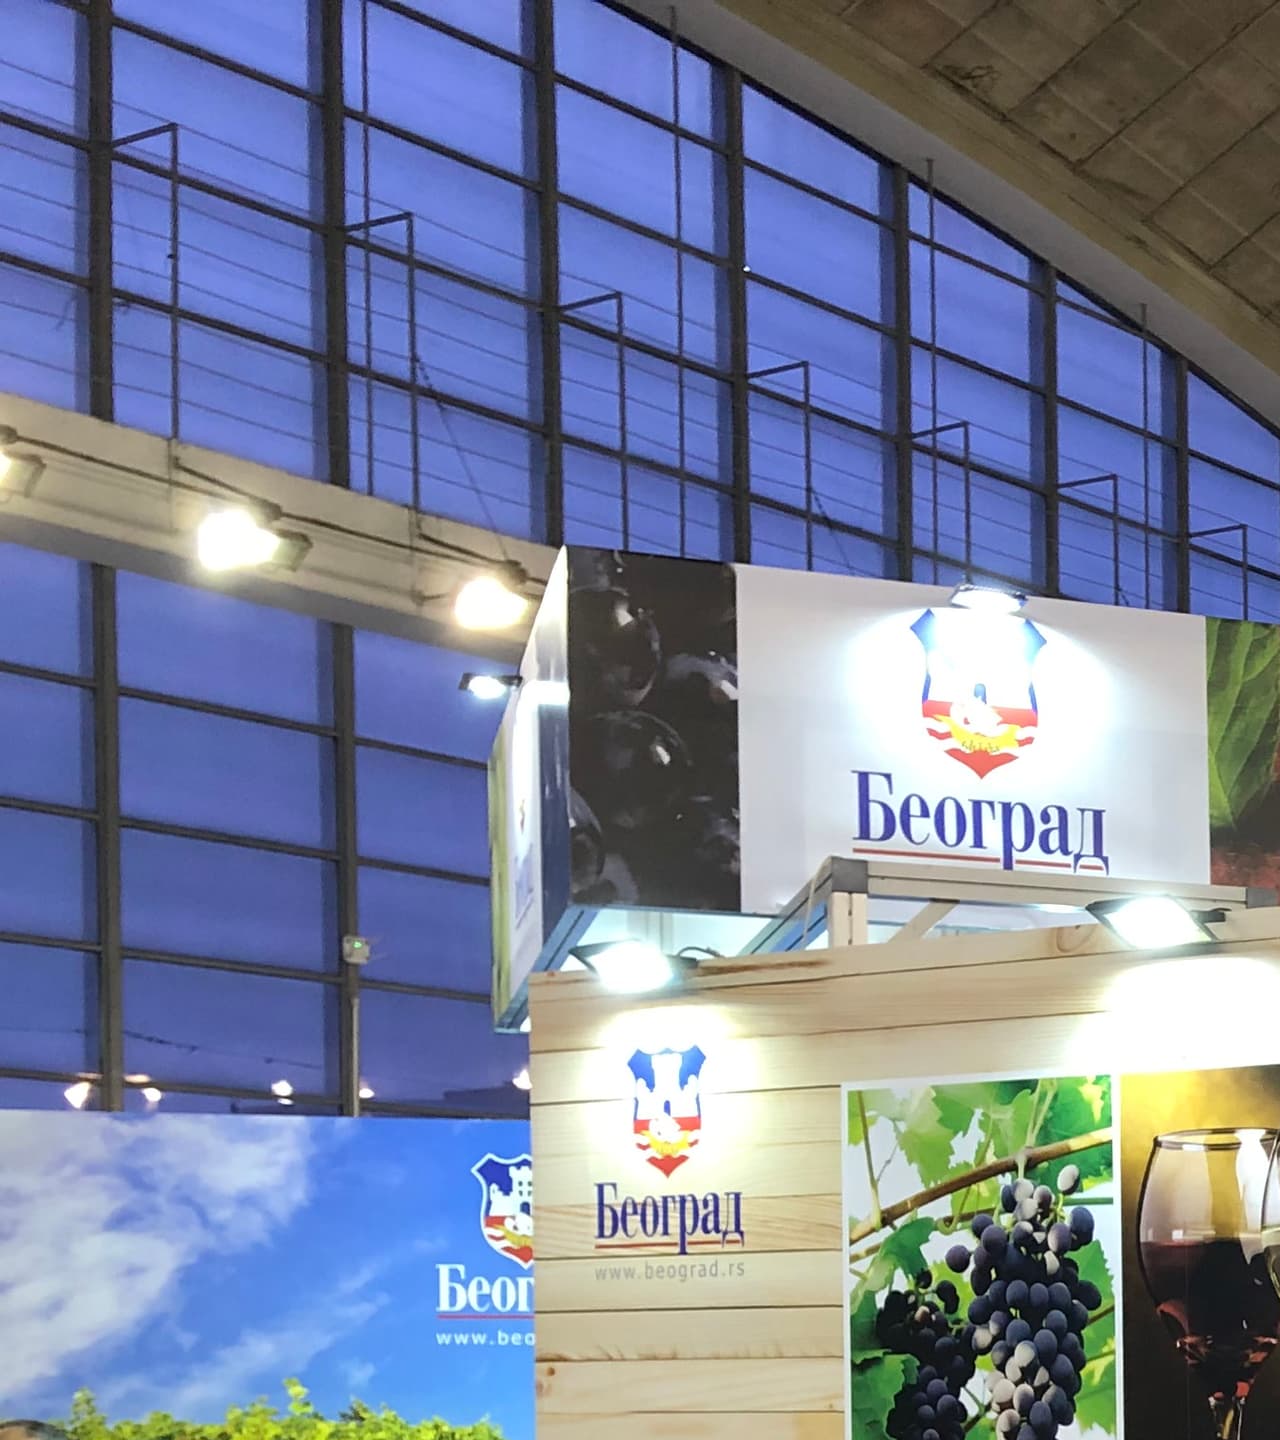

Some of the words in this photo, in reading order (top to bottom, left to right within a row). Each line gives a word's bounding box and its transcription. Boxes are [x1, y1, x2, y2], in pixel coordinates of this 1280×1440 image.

[851, 770, 1110, 876] Београд
[594, 1181, 746, 1256] Београд
[435, 1263, 535, 1313] Беог
[594, 1258, 746, 1283] www.beograd.rs
[435, 1329, 536, 1346] www.beo
